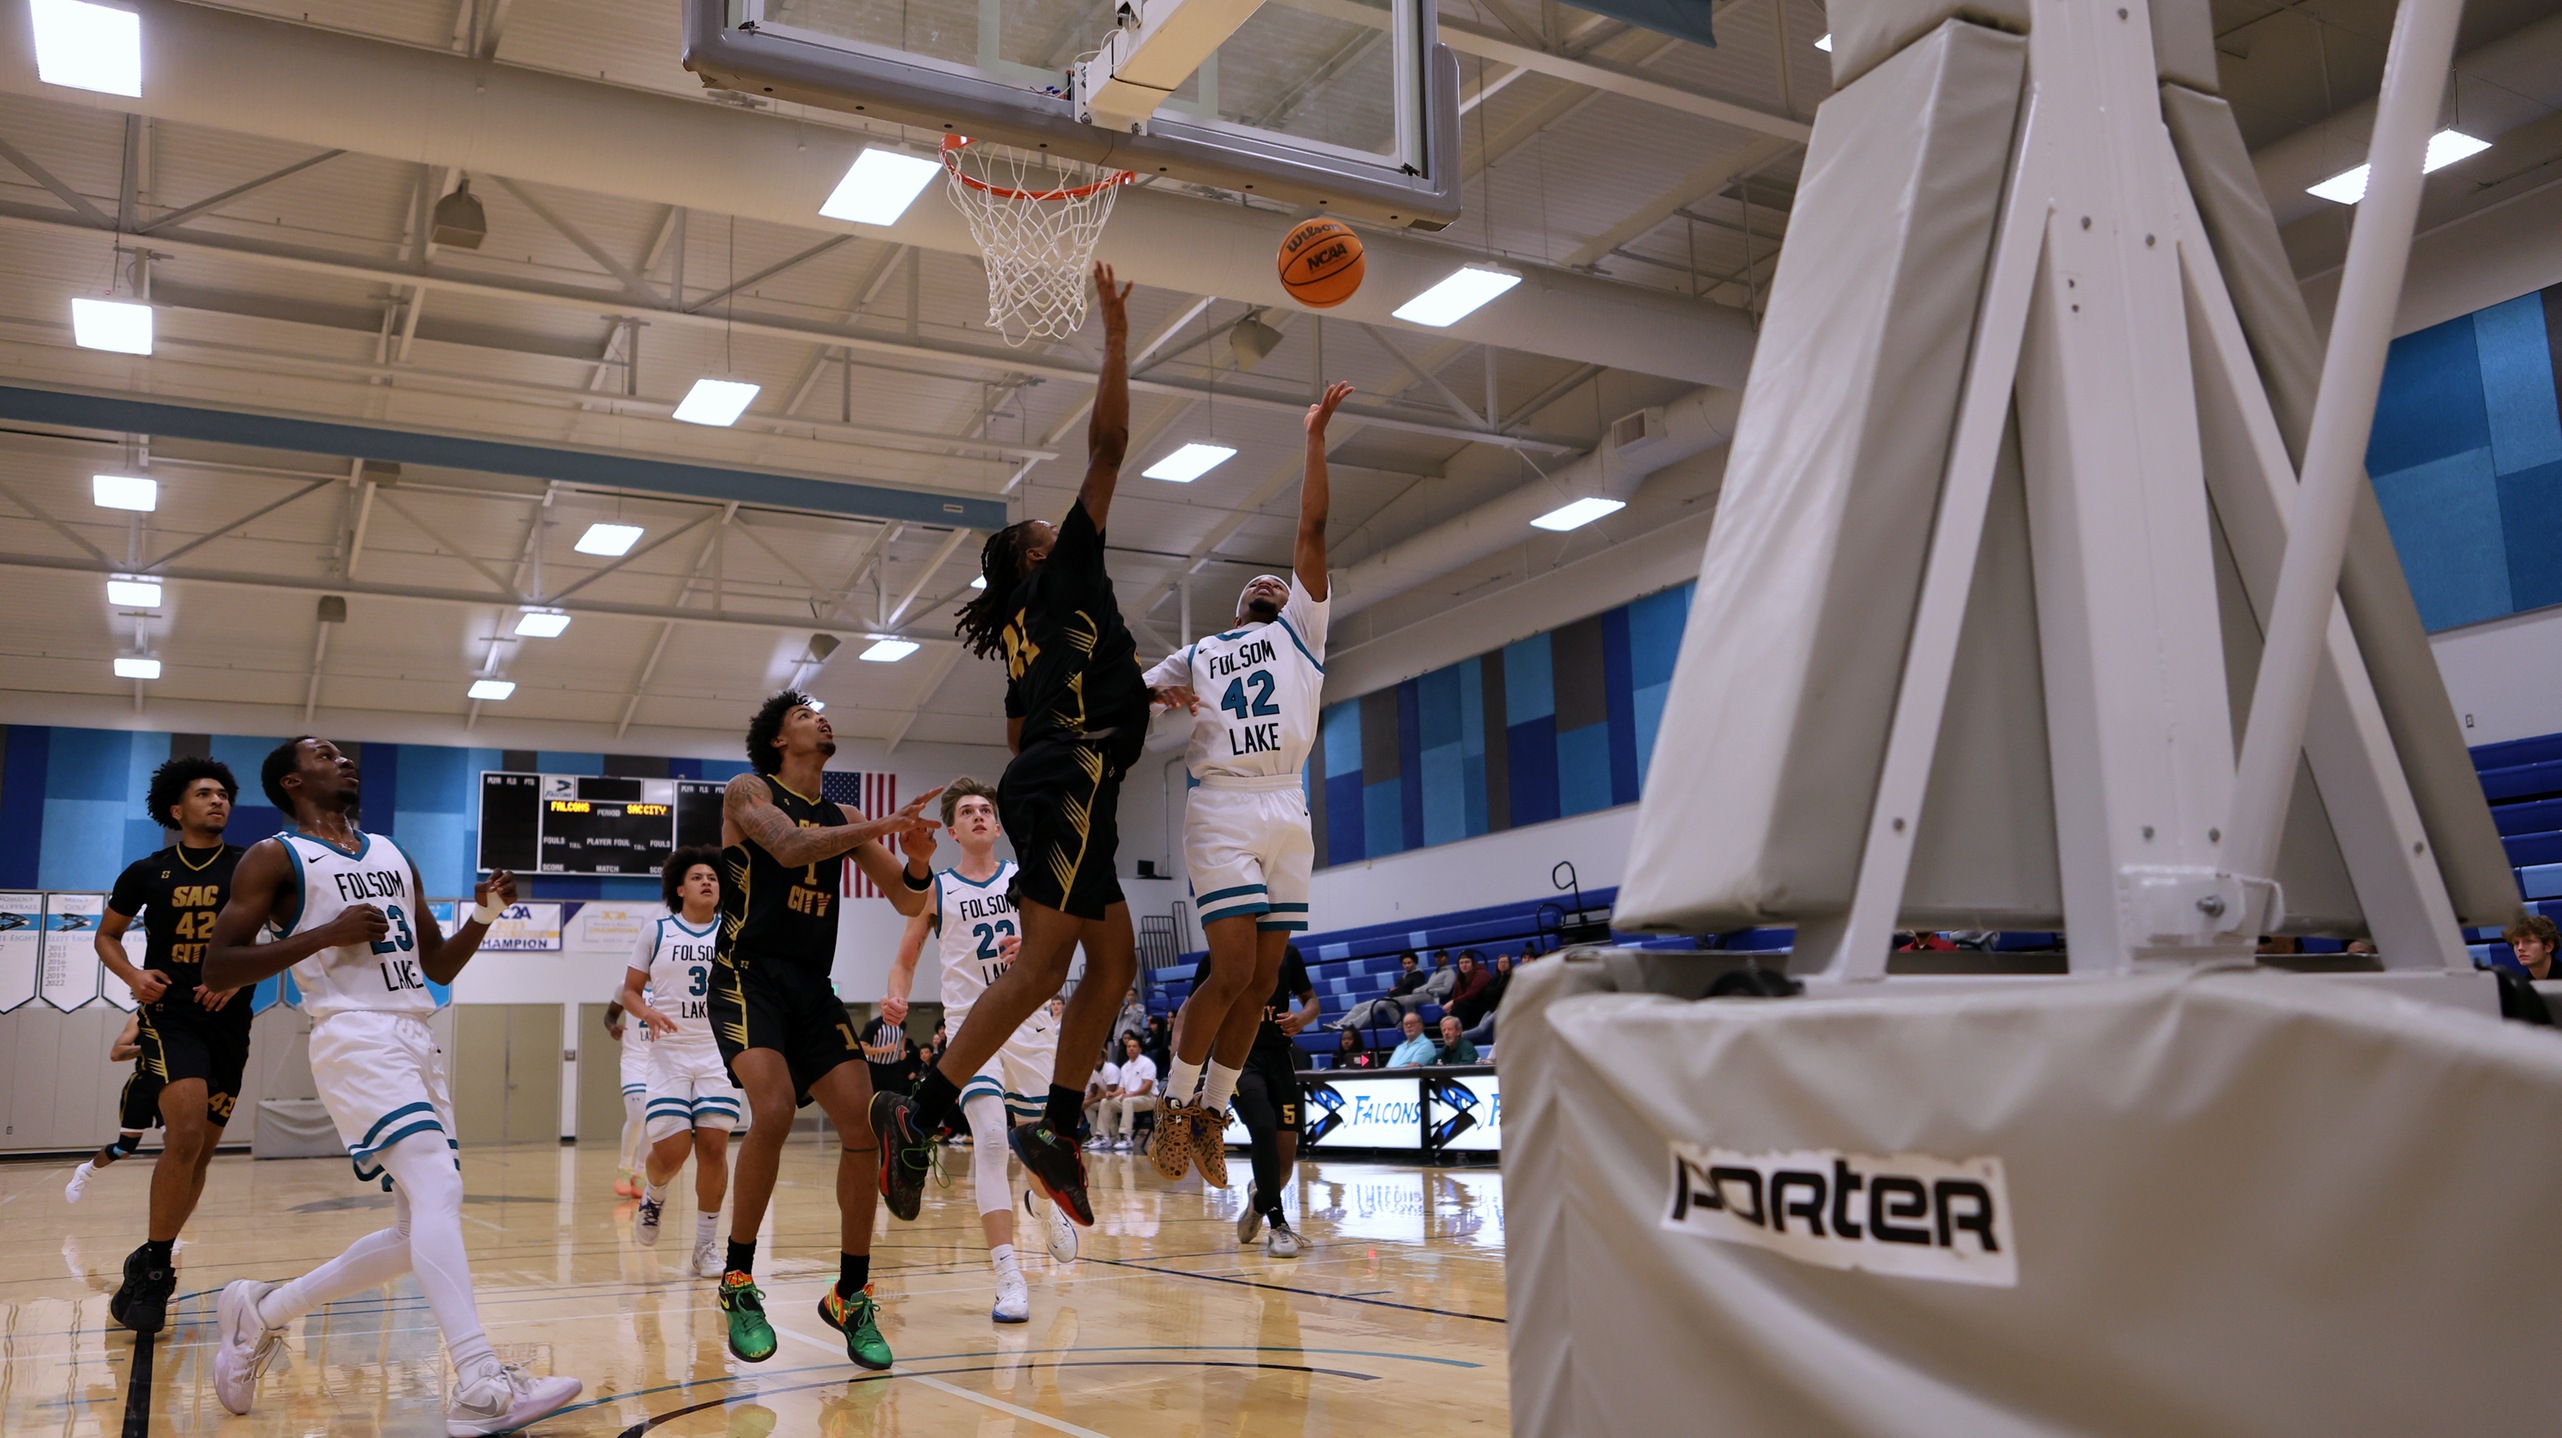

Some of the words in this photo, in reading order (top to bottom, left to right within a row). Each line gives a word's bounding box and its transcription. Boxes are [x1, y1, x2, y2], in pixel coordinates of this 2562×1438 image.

[1286, 223, 1342, 252] Wilson
[1306, 242, 1347, 271] NCAA
[1209, 639, 1276, 679] FOLSOM
[1221, 669, 1280, 719] 42
[1229, 722, 1280, 756] LAKE
[551, 801, 590, 813] FALCONS
[596, 809, 621, 817] PERIOD
[543, 836, 566, 845] FOULS
[586, 838, 612, 847] PLAYER
[650, 840, 671, 848] FOULS
[542, 864, 564, 872] SCORE
[596, 865, 620, 873] MATCH
[649, 866, 664, 874] SCO
[171, 885, 219, 907] SAC
[334, 870, 405, 902] FOLSOM
[787, 885, 832, 917] CITY
[175, 911, 217, 940] 42
[171, 943, 209, 964] CIT
[482, 939, 547, 949] HAMPION
[672, 945, 715, 962] FOLSO
[380, 960, 424, 992] LAKE
[689, 966, 707, 996] 3
[682, 1001, 707, 1019] LAK
[836, 1023, 860, 1051] 1
[1282, 1103, 1296, 1125] 5
